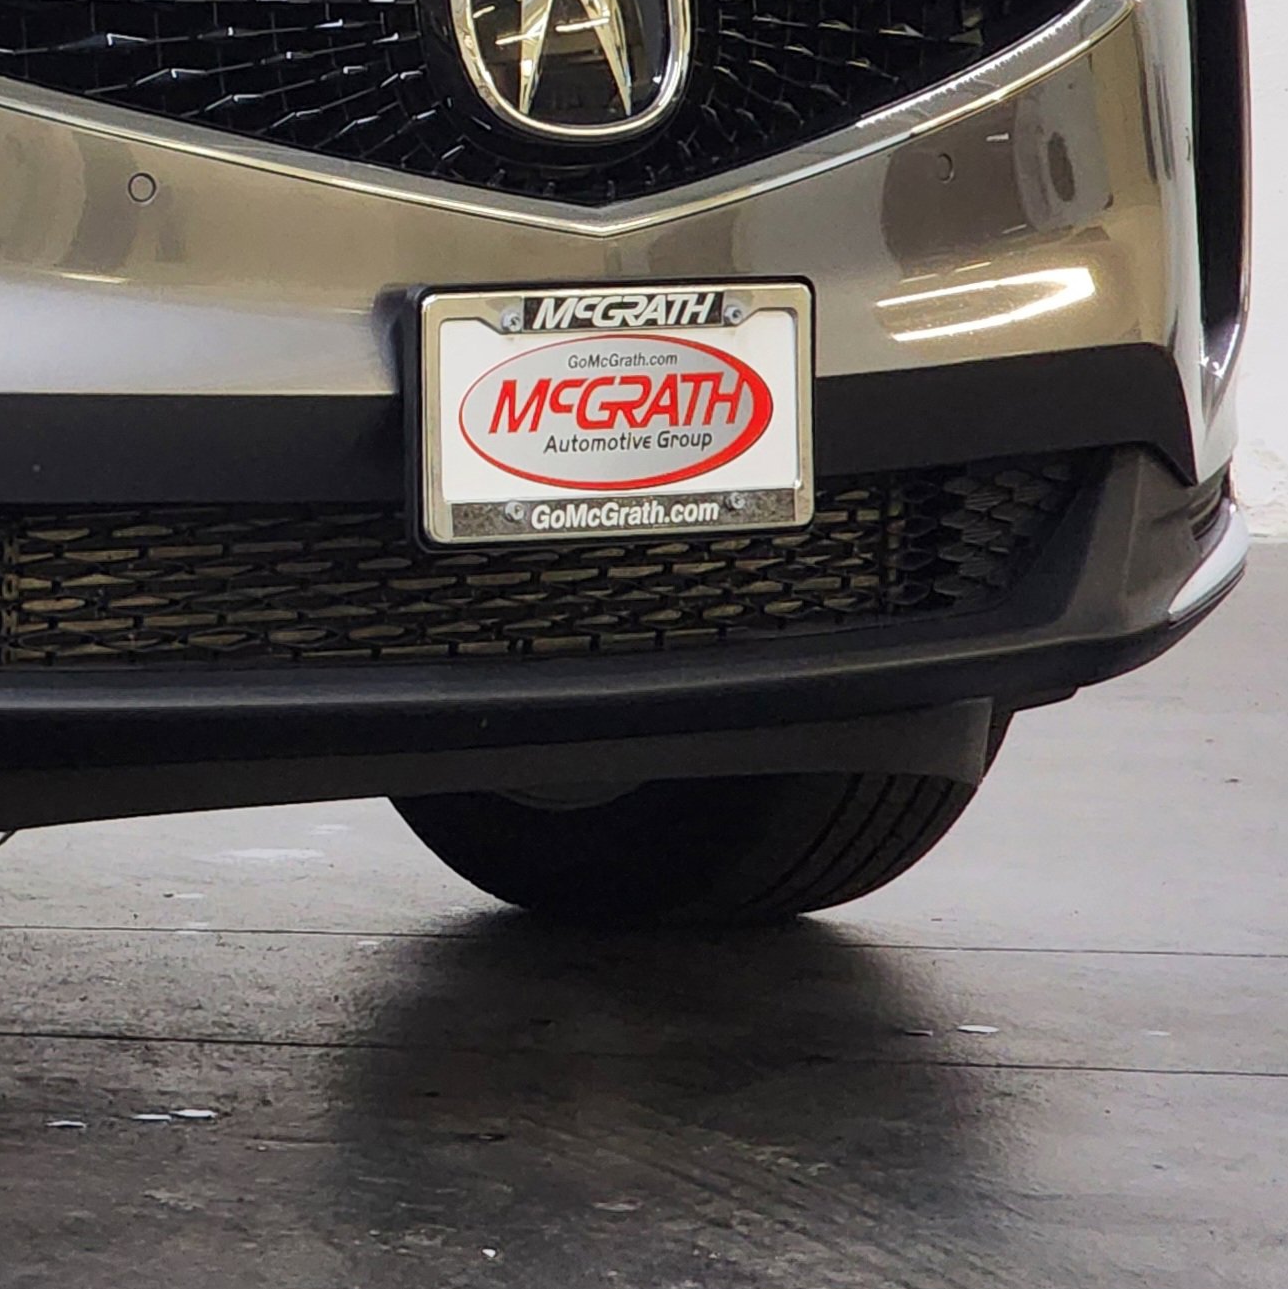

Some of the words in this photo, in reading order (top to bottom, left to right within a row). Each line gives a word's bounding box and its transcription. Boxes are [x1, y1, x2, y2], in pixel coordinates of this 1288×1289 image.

[532, 292, 715, 330] McGRATH
[567, 353, 678, 370] GoMcGrath.com
[488, 371, 746, 434] McGRATH
[543, 431, 652, 454] Automotive
[656, 429, 713, 452] Group
[531, 500, 719, 530] GoMcGrath.com
